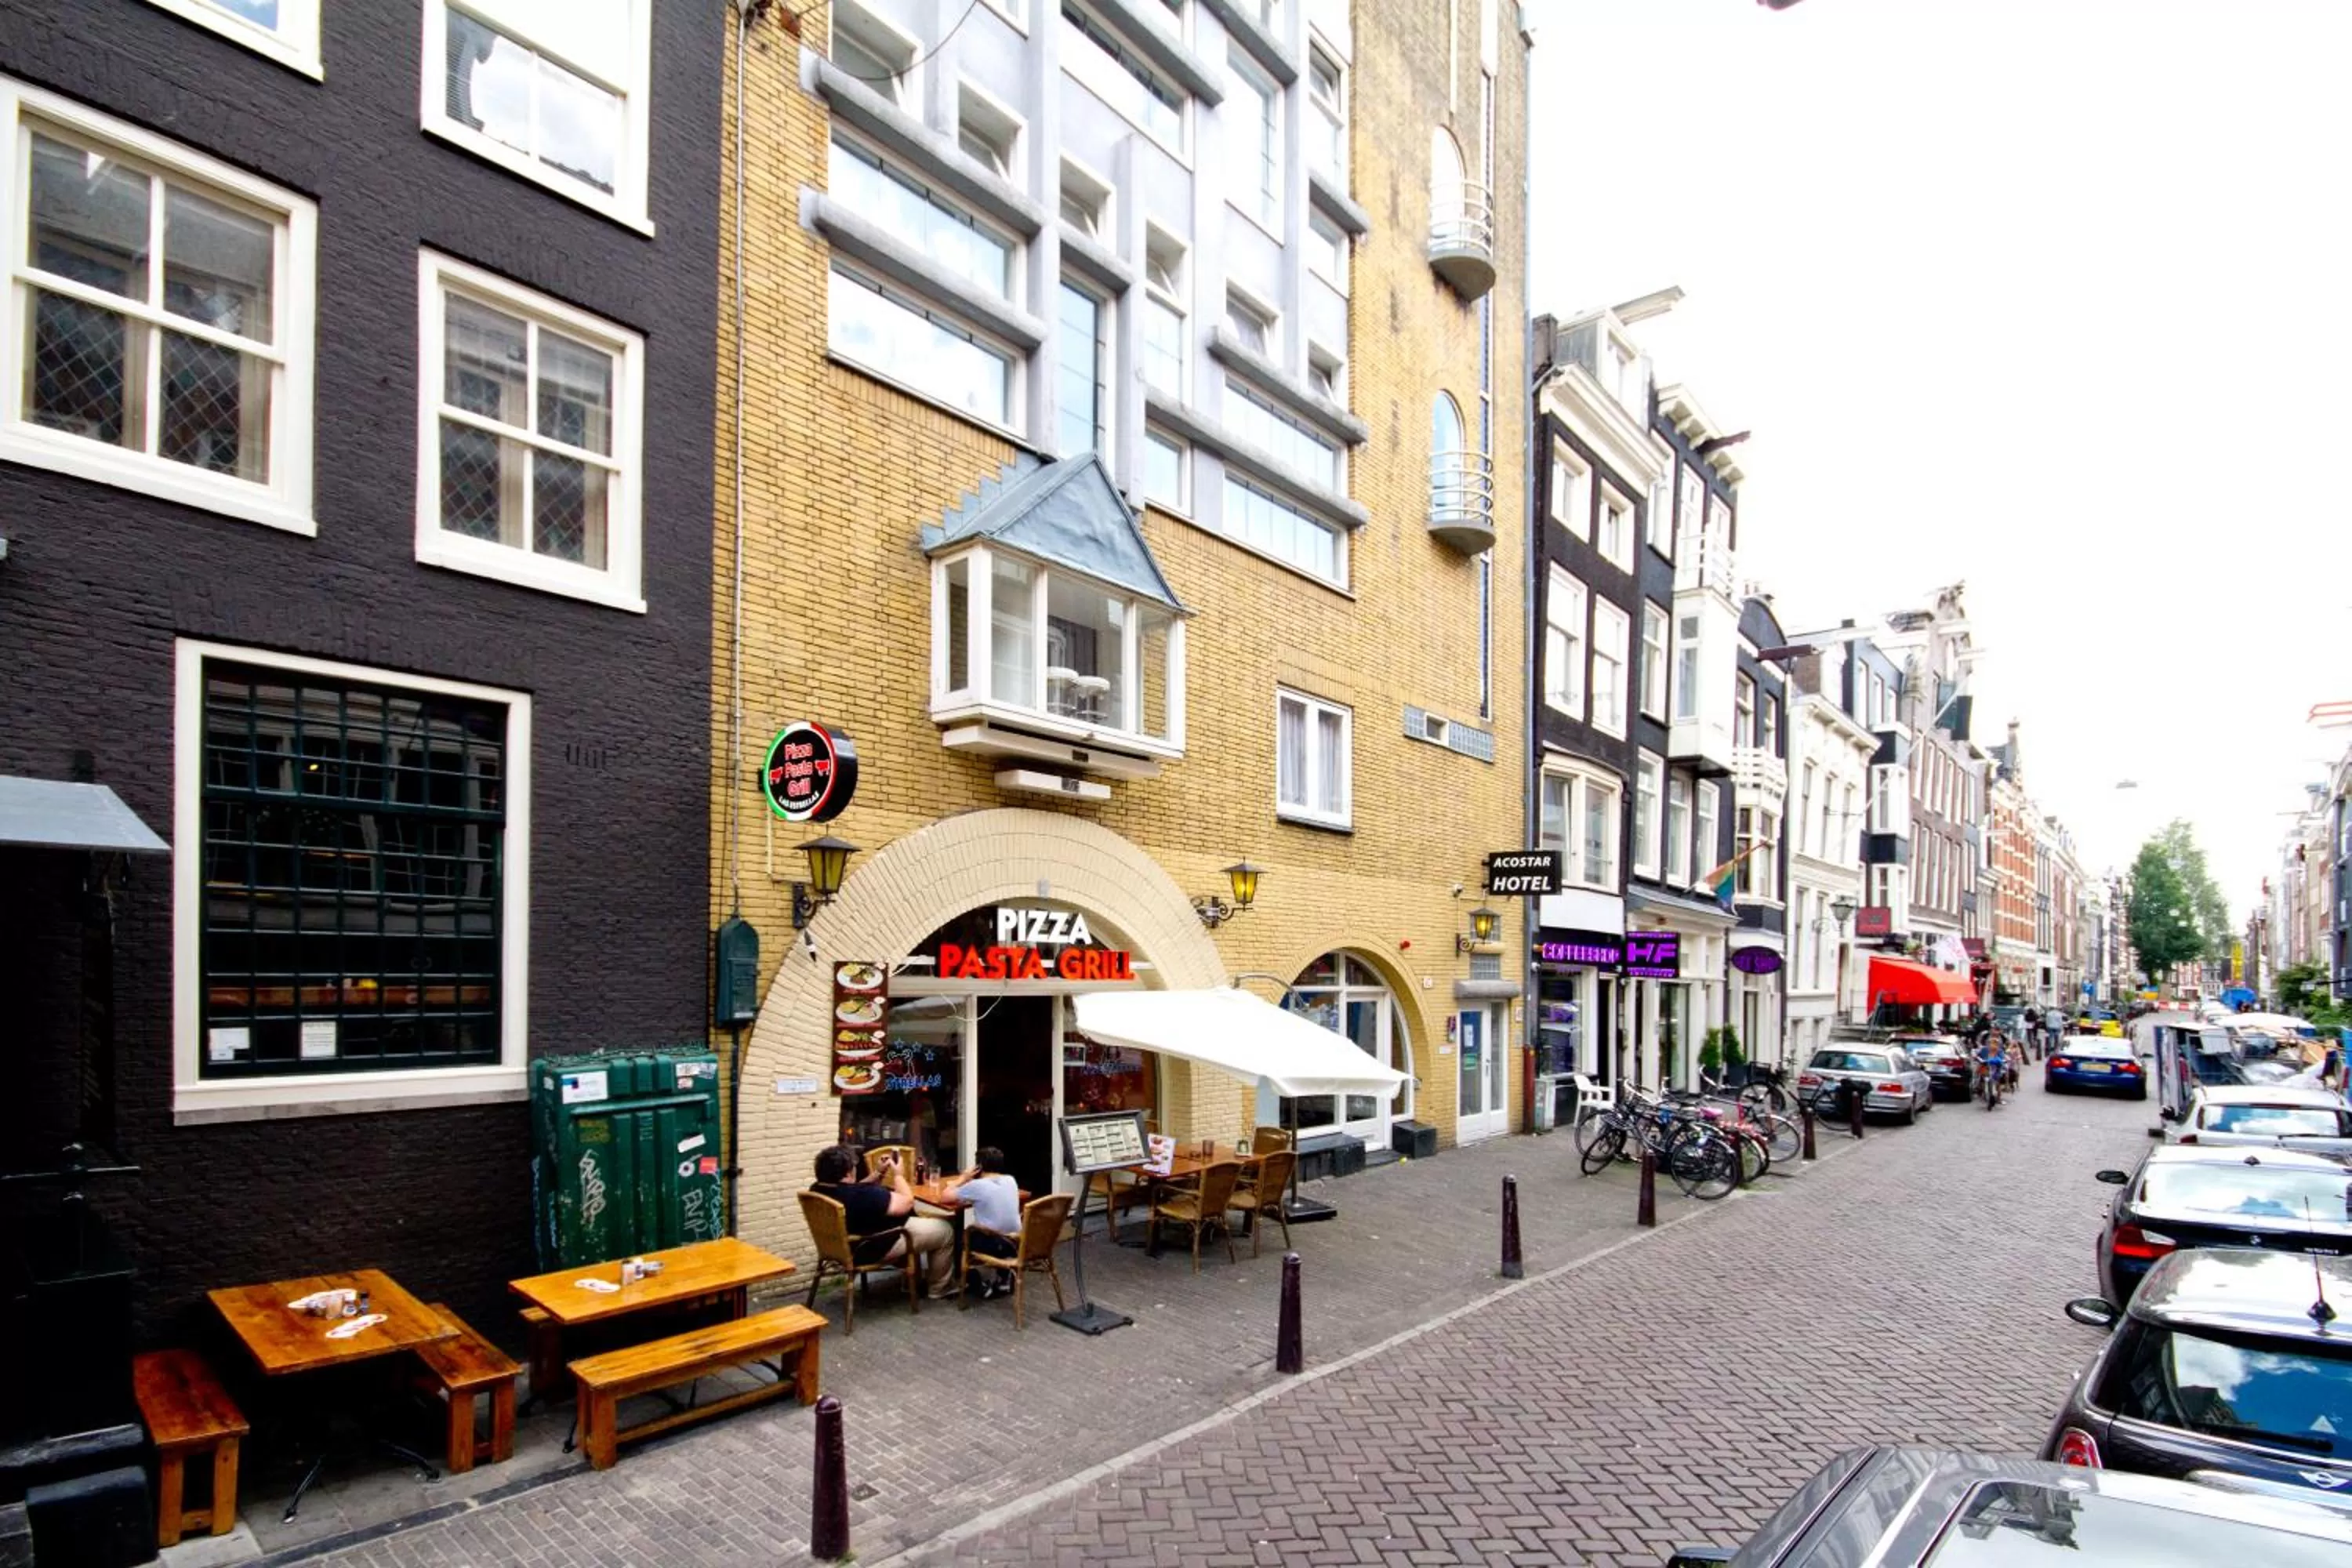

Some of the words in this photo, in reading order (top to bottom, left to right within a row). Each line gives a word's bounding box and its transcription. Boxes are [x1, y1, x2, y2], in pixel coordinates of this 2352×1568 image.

[785, 742, 813, 760] Pizza
[785, 760, 813, 779] Pasta
[787, 778, 811, 797] Grill
[1493, 856, 1552, 868] ACOSTAR
[1493, 876, 1552, 891] HOTEL
[996, 907, 1093, 946] PIZZA
[938, 944, 1048, 979] PASTA
[1058, 946, 1135, 981] GRILL
